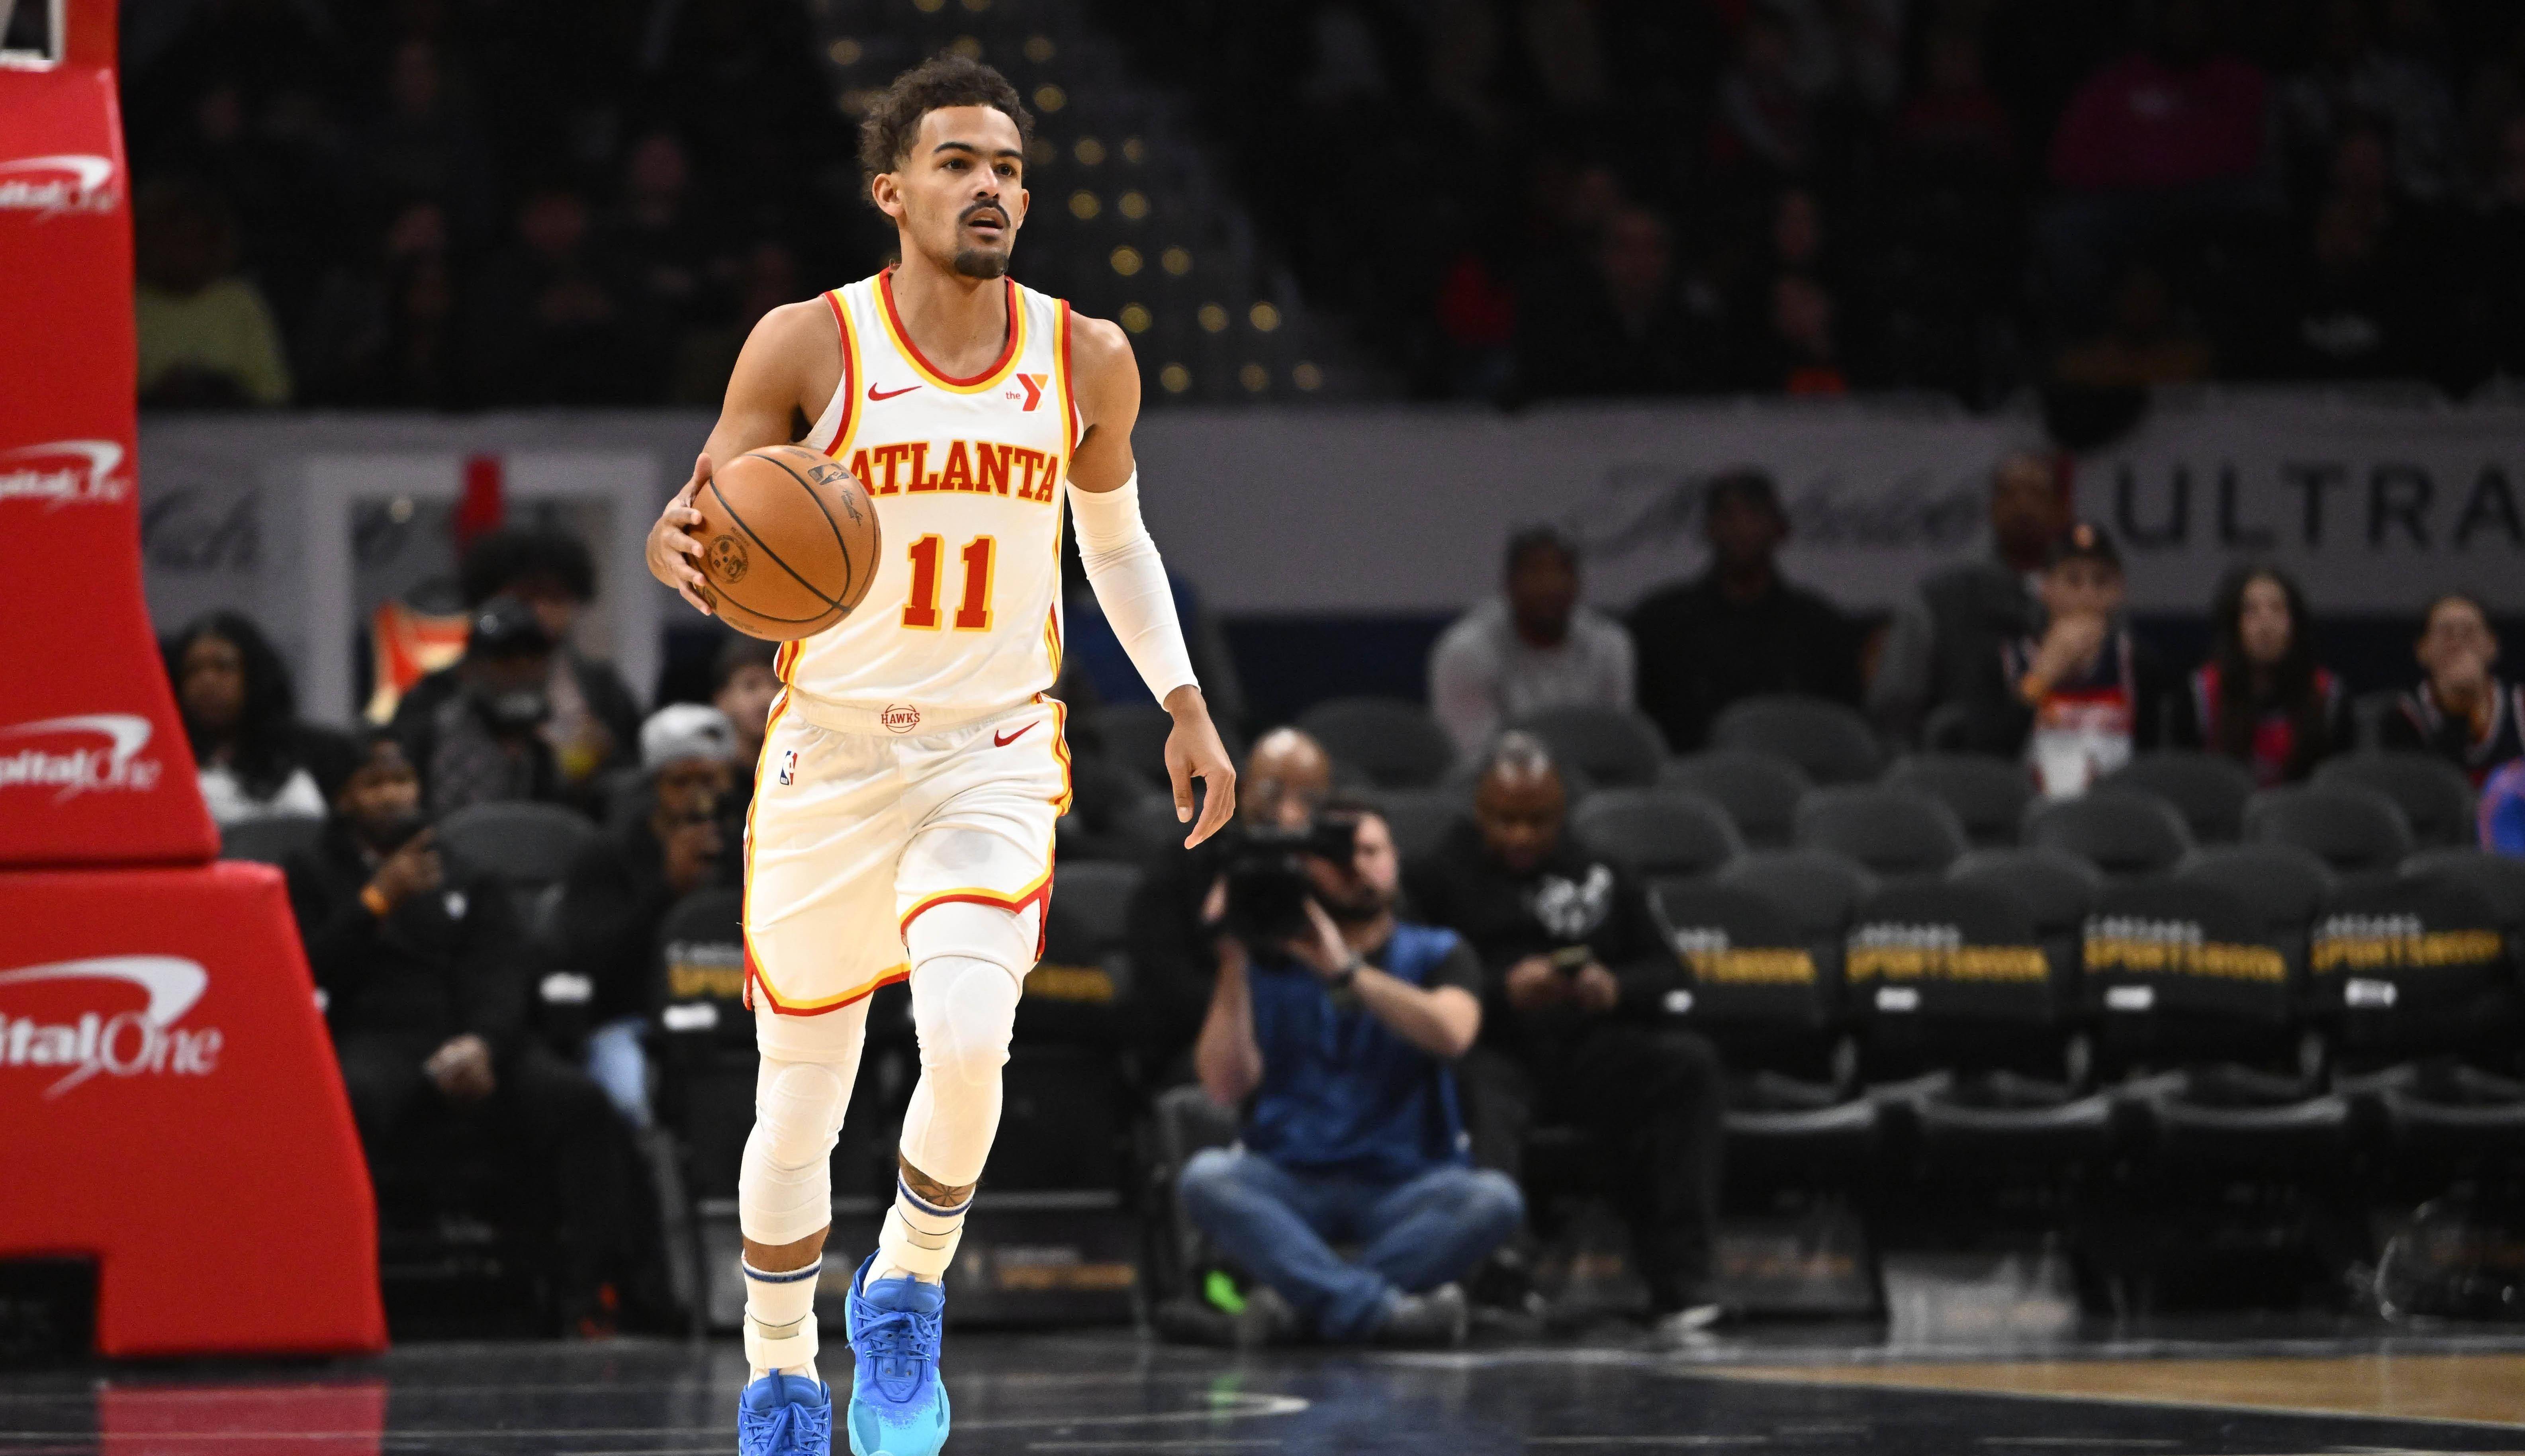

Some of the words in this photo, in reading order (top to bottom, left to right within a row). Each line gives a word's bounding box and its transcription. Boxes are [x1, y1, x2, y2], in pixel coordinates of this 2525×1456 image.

[1006, 391, 1020, 399] the
[851, 440, 1059, 505] ATLANTA
[2116, 463, 2525, 548] ULTRA
[901, 533, 996, 632] 11
[881, 712, 920, 724] HAWKS
